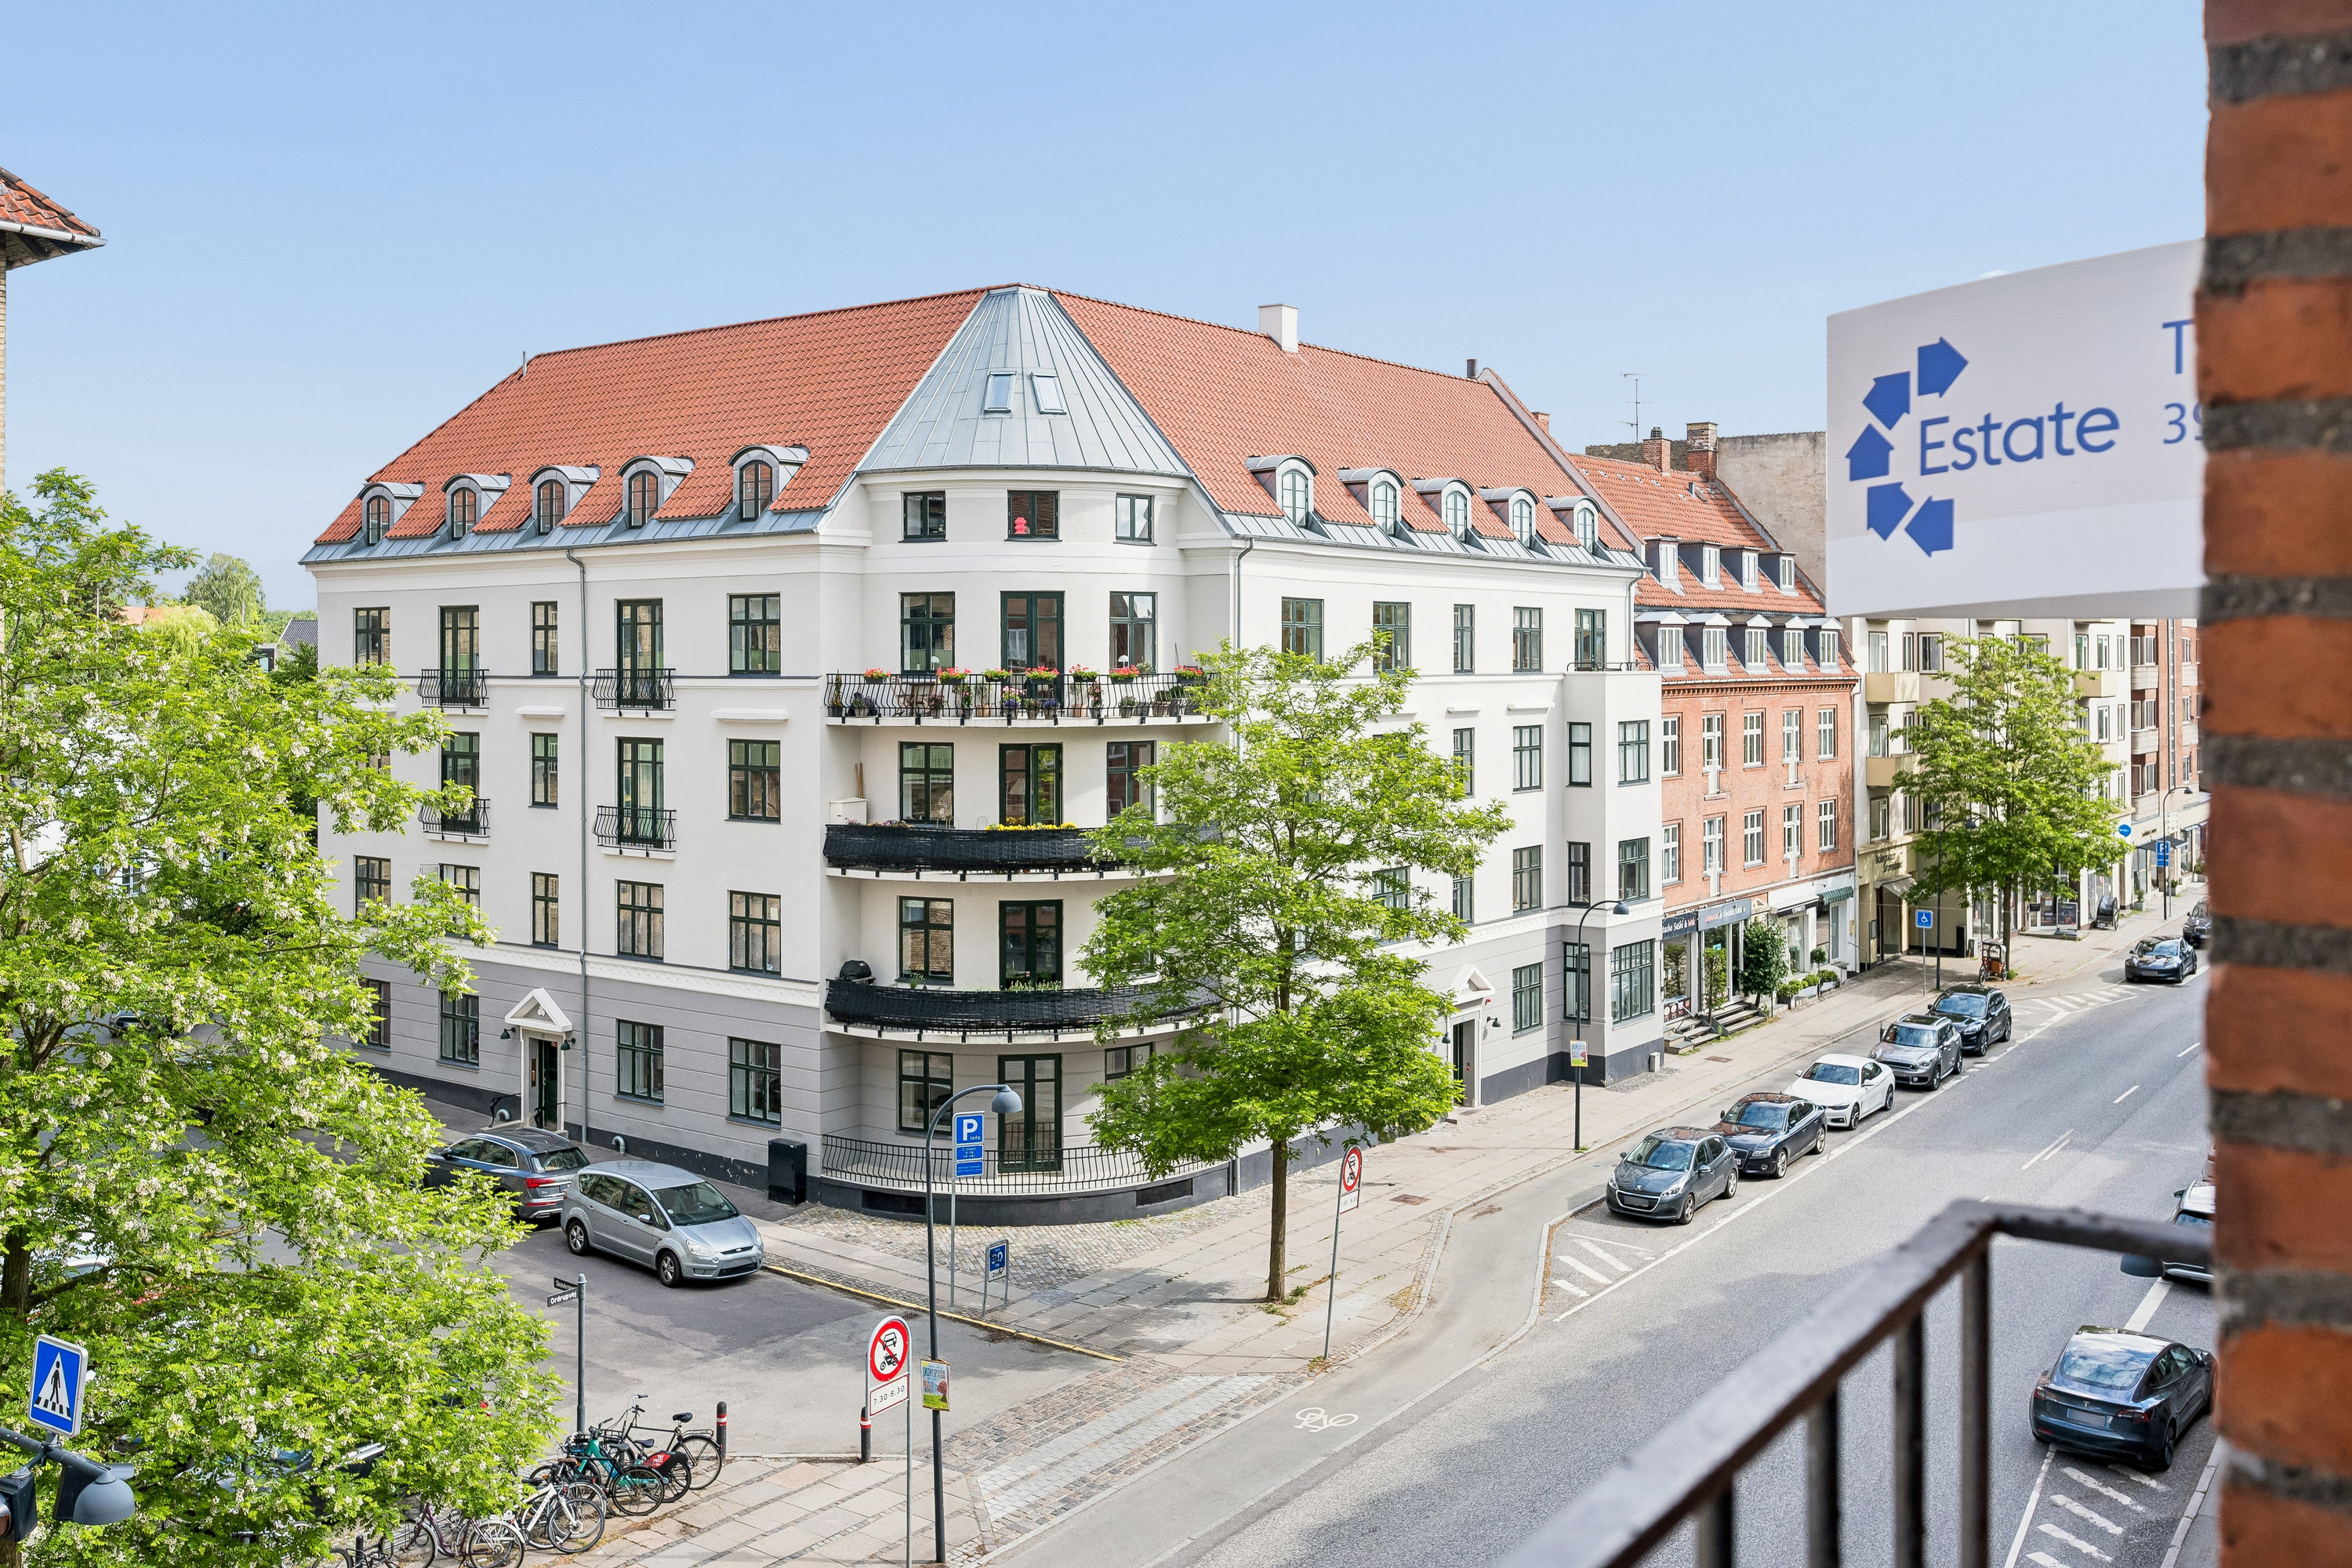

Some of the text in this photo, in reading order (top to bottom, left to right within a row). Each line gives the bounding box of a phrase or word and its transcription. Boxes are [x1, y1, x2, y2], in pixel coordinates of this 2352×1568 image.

[2162, 318, 2194, 374] T
[1920, 401, 2120, 476] Estate
[963, 1119, 978, 1142] P
[550, 1291, 576, 1304] Ordrupvej
